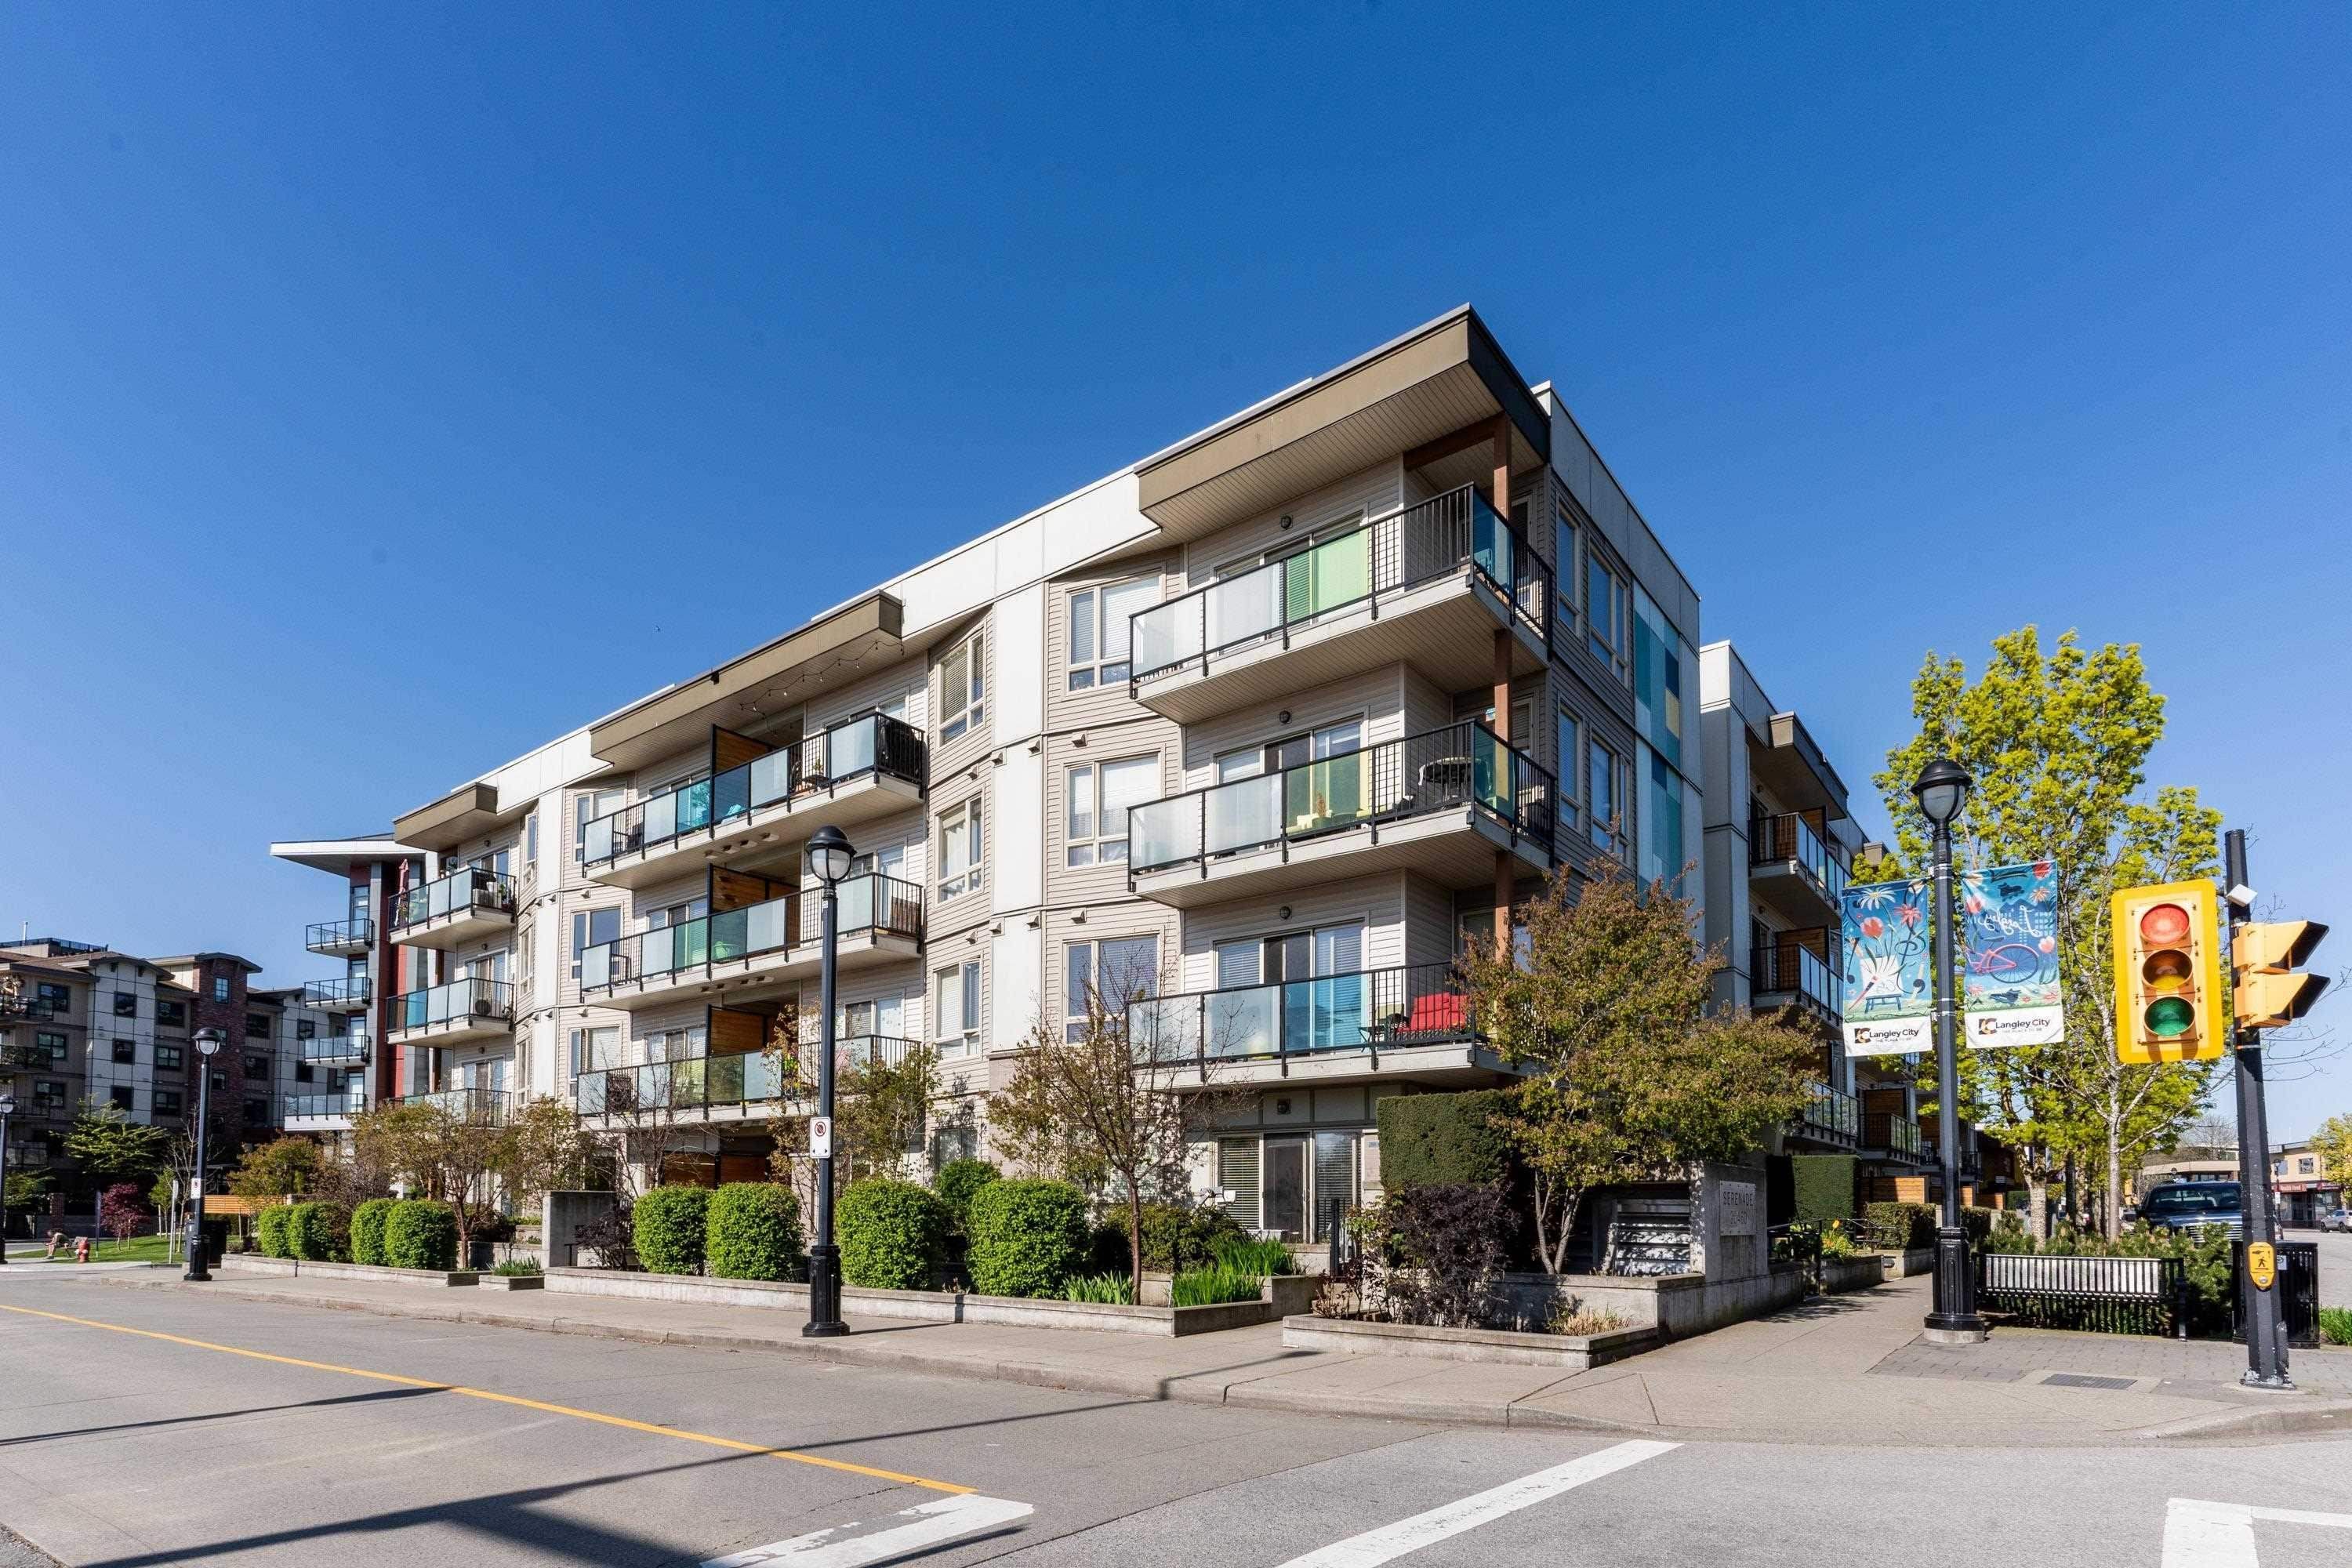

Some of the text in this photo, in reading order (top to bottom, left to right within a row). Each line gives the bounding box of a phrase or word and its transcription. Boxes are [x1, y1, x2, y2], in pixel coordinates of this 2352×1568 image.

[1995, 1020, 2031, 1029] Langley
[2032, 1018, 2050, 1027] City
[1722, 1191, 1754, 1207] SERENADE
